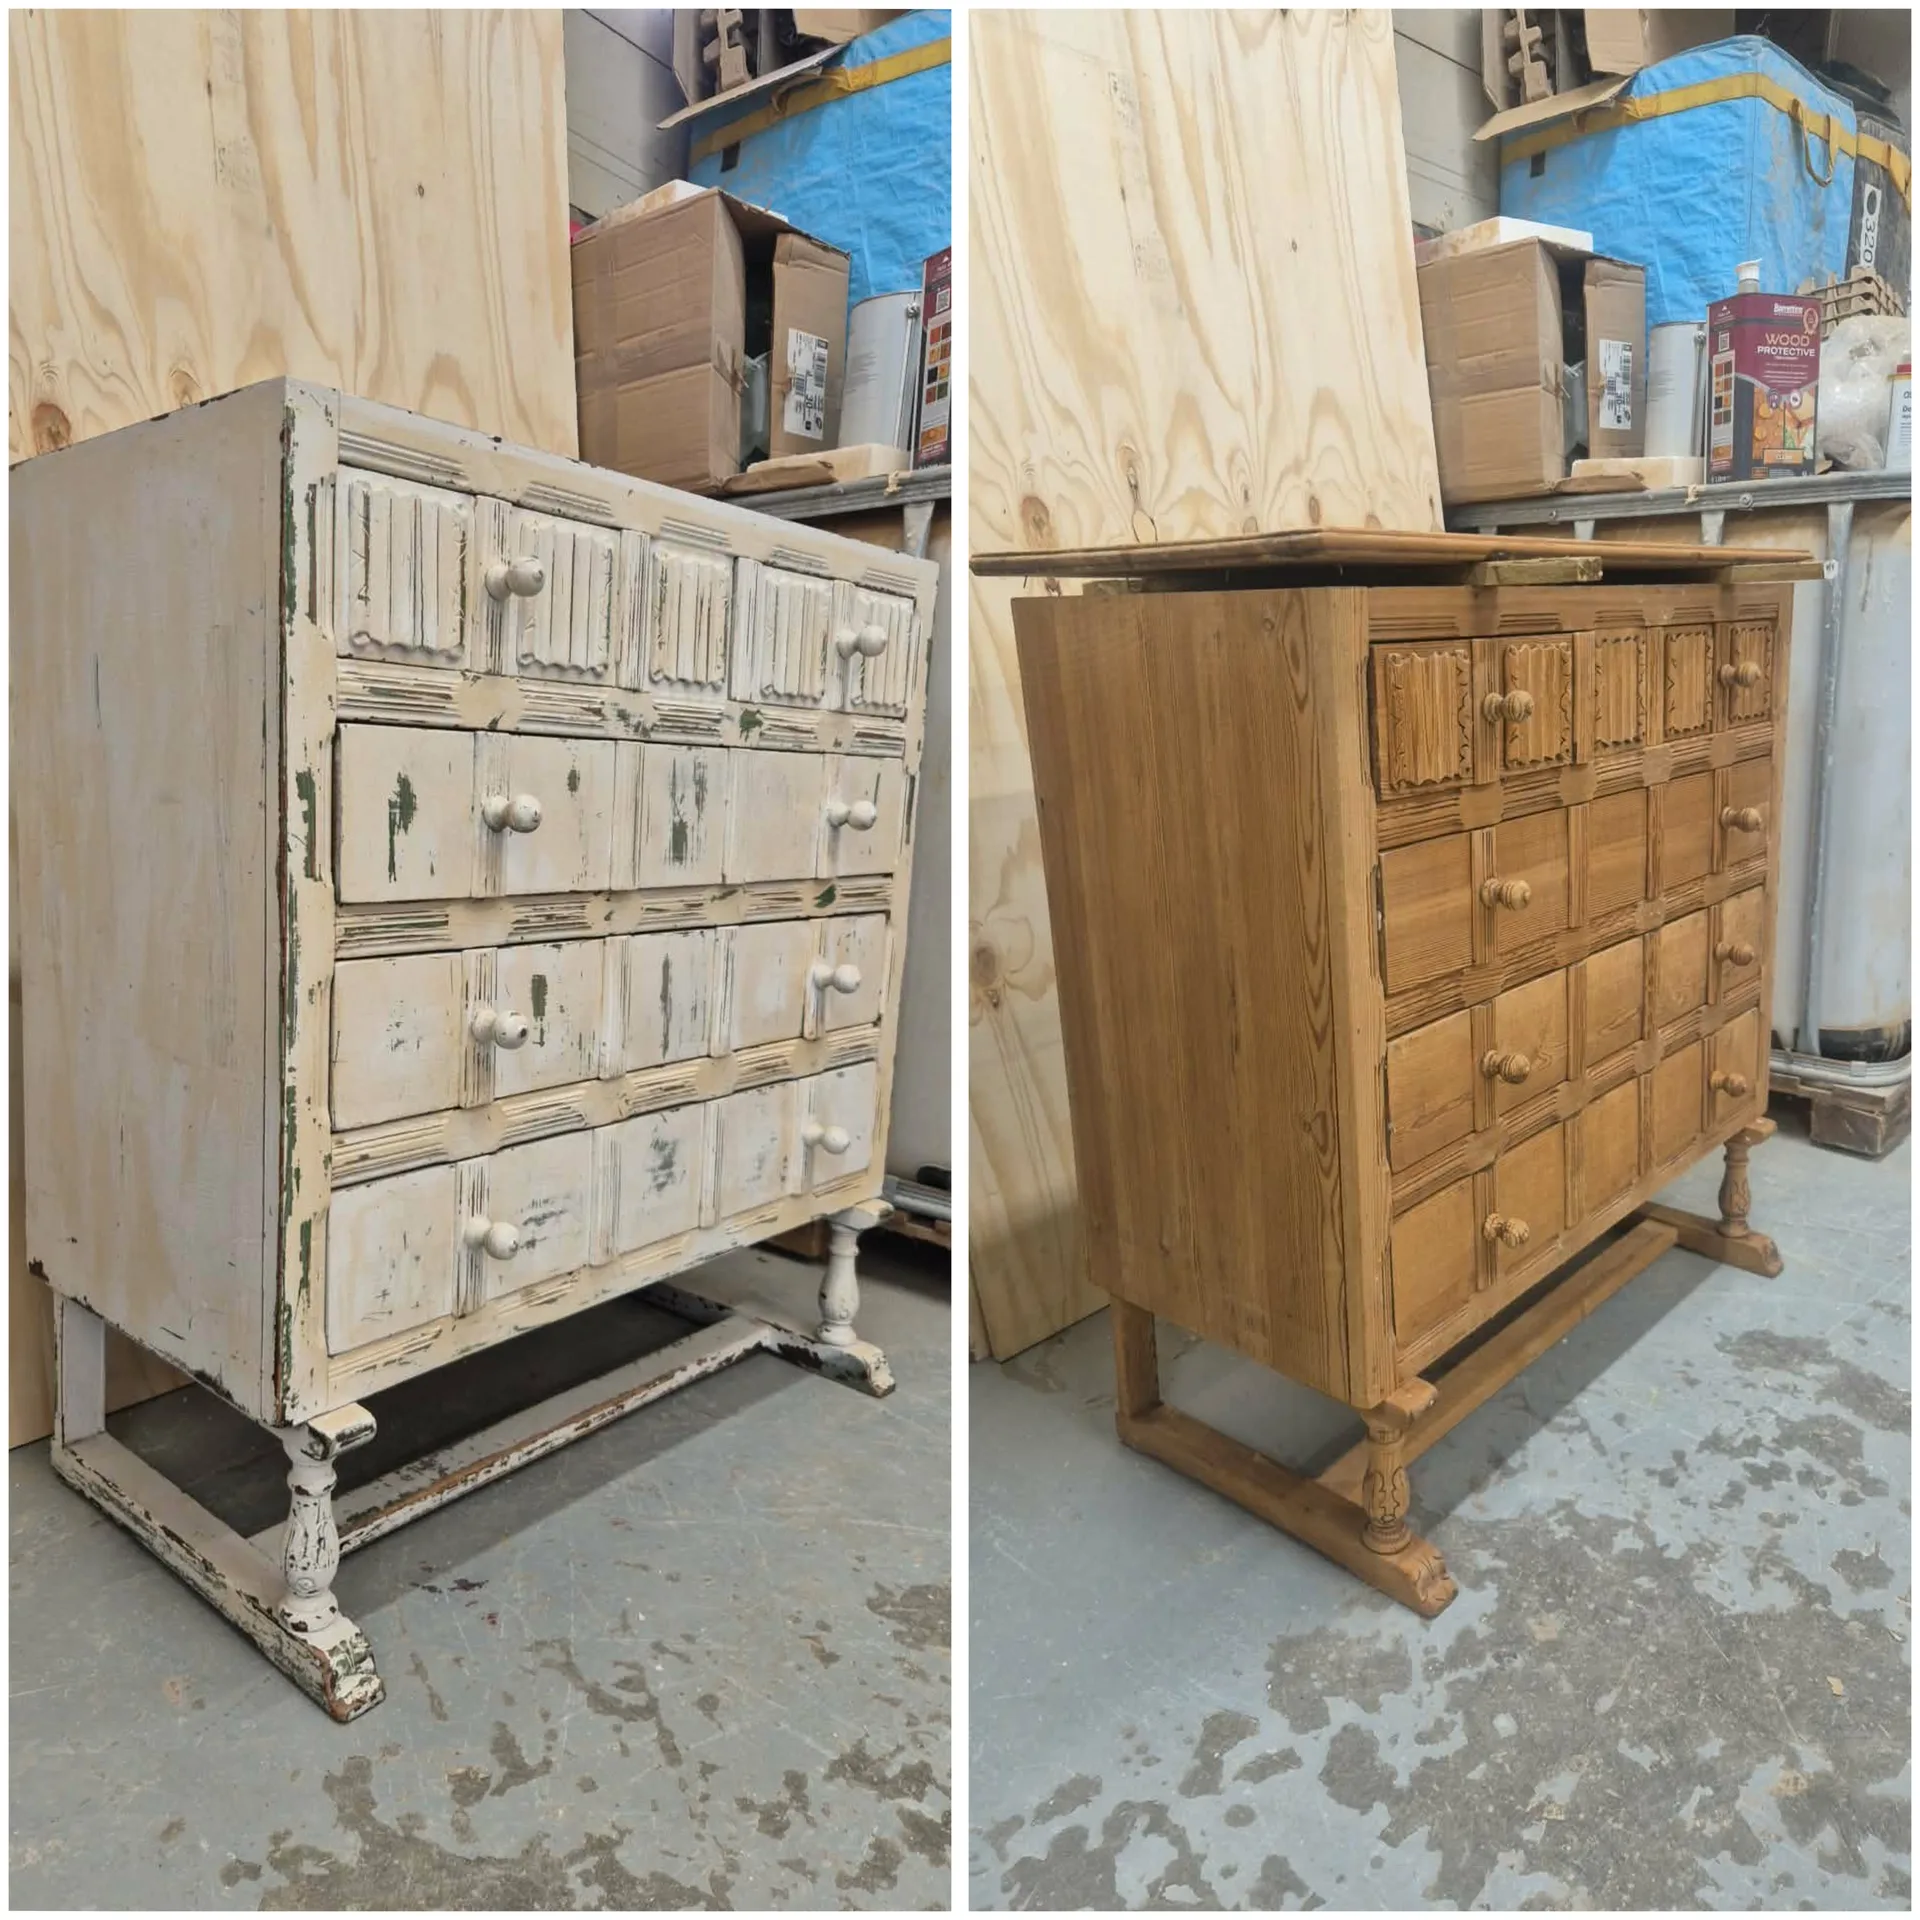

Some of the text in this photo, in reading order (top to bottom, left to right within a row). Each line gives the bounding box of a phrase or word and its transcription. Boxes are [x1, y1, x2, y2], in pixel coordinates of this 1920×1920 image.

[1862, 218, 1876, 264] 320
[1765, 332, 1810, 347] WOOD
[1757, 346, 1816, 357] PROTECTIVE
